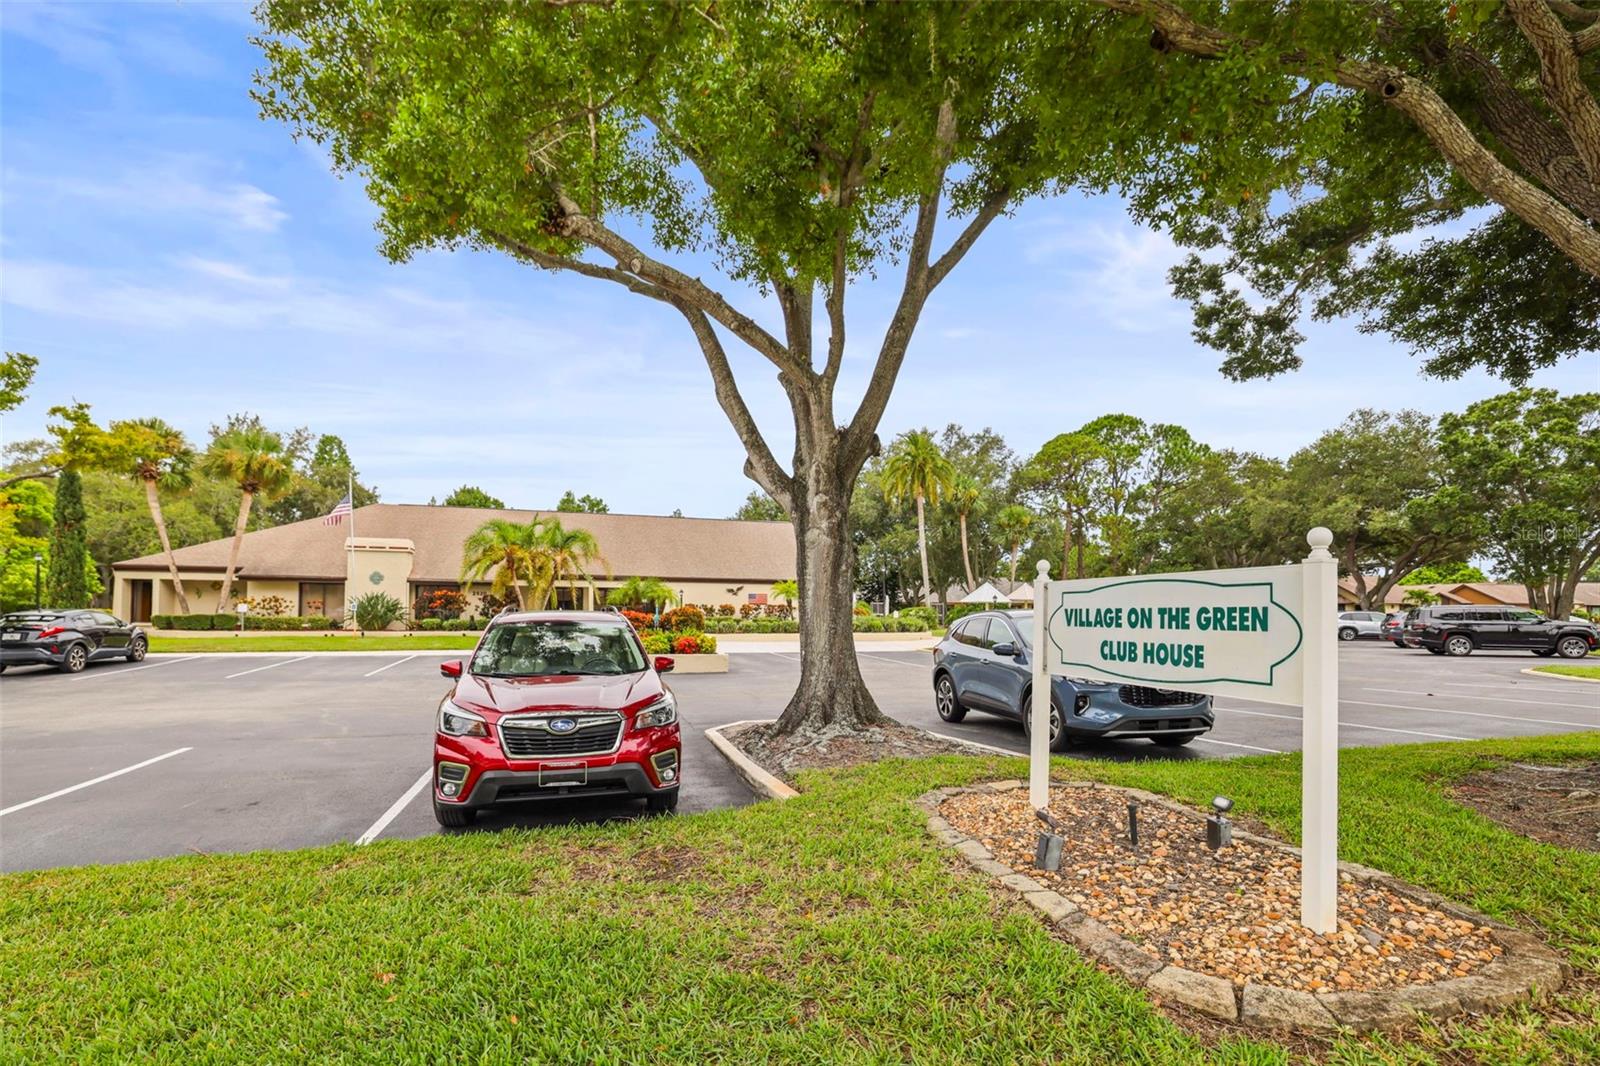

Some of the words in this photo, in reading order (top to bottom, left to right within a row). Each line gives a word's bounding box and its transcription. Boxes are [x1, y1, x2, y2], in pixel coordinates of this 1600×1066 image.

[1064, 607, 1122, 629] VILLAGE
[1127, 607, 1153, 630] ON
[1158, 607, 1190, 631] THE
[1196, 606, 1269, 632] GREEN
[1100, 639, 1138, 662] CLUB
[1143, 643, 1205, 669] HOUSE
